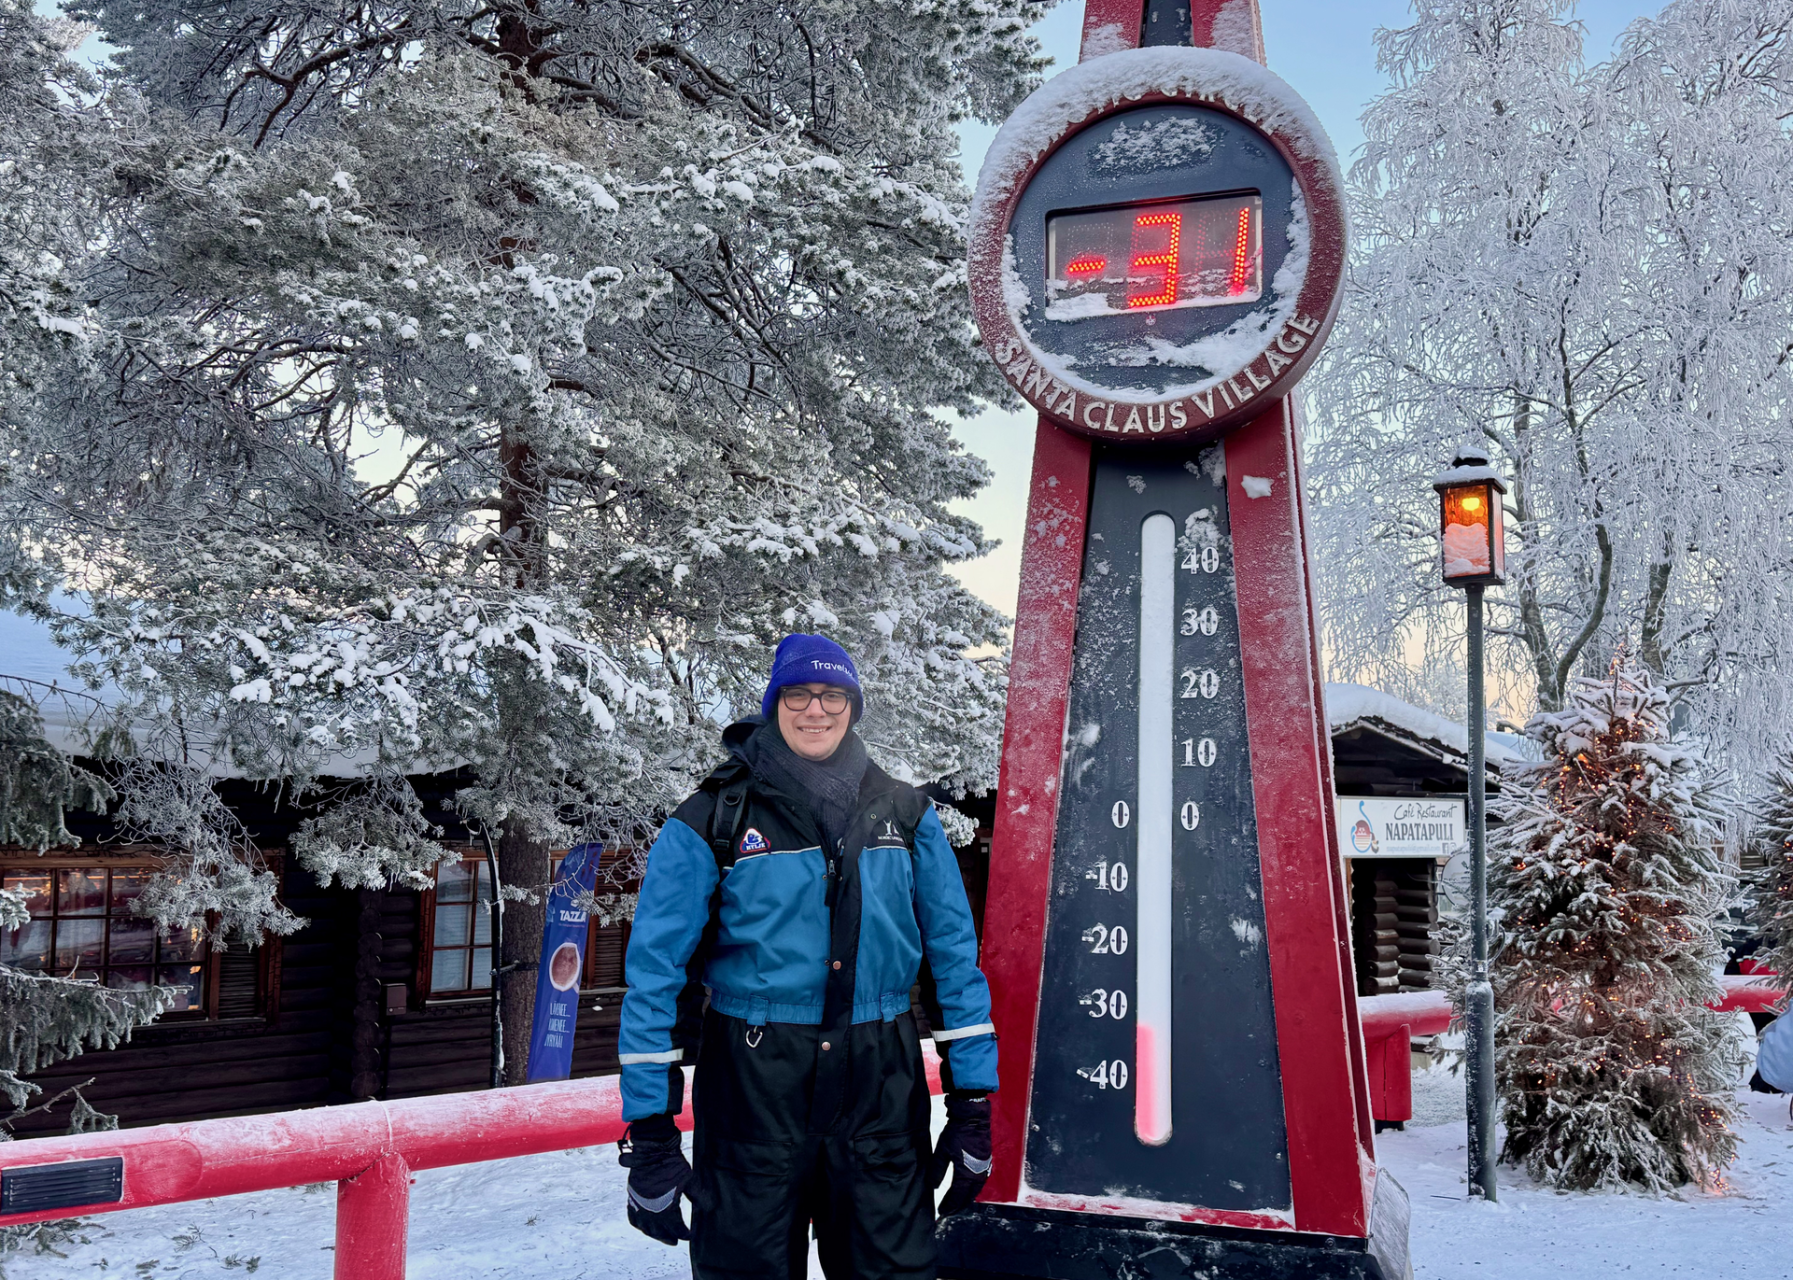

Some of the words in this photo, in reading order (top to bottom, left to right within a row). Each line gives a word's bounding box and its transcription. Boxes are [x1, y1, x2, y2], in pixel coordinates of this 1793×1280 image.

[995, 339, 1076, 421] SANTA
[1083, 401, 1188, 434] CLAUS
[1192, 313, 1320, 419] VILLAGE
[1181, 546, 1220, 575] 40
[1180, 608, 1219, 636] 30
[1180, 670, 1219, 699] 20
[1181, 738, 1218, 767] 10
[1111, 800, 1130, 829] 0
[1180, 802, 1200, 830] 0
[1394, 803, 1415, 820] Café
[1416, 802, 1457, 820] Restaurant
[1386, 822, 1454, 841] NAPATAPULI
[1085, 861, 1128, 892] -10
[559, 909, 587, 923] TAZZA
[1081, 923, 1128, 955] -20
[1079, 988, 1128, 1020] -30
[1076, 1059, 1128, 1090] -40
